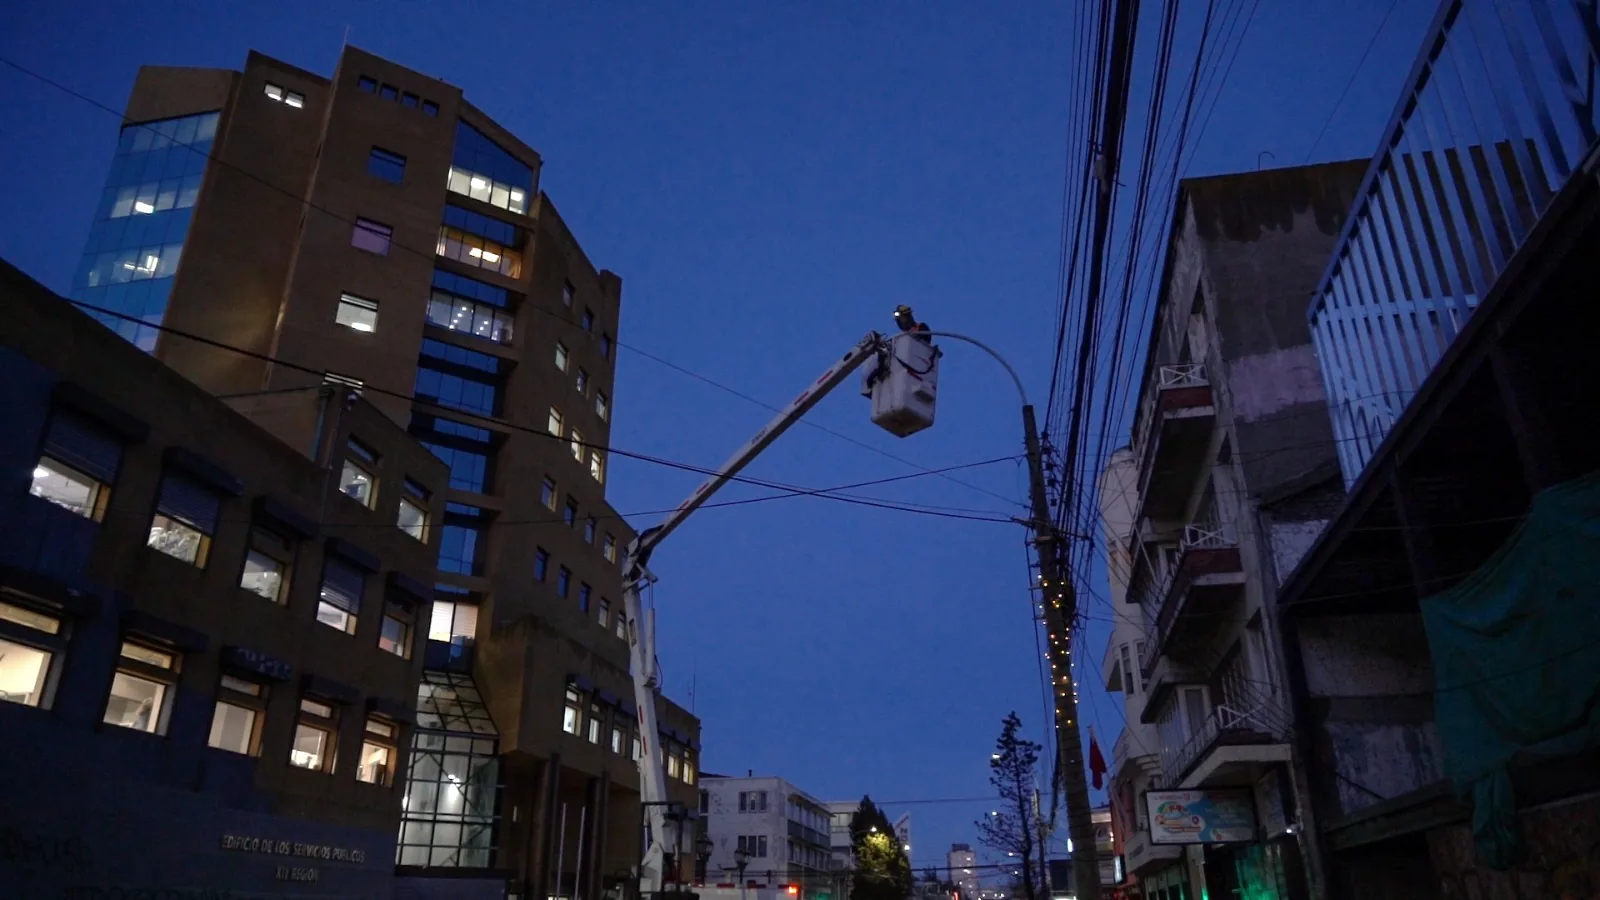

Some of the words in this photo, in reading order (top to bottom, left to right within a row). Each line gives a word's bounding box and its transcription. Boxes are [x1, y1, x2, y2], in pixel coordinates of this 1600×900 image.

[222, 834, 259, 851] EDIFICIO
[261, 839, 272, 853] DE
[274, 840, 290, 856] LOS
[292, 842, 331, 860] SERVICIOS
[275, 864, 289, 880] XII
